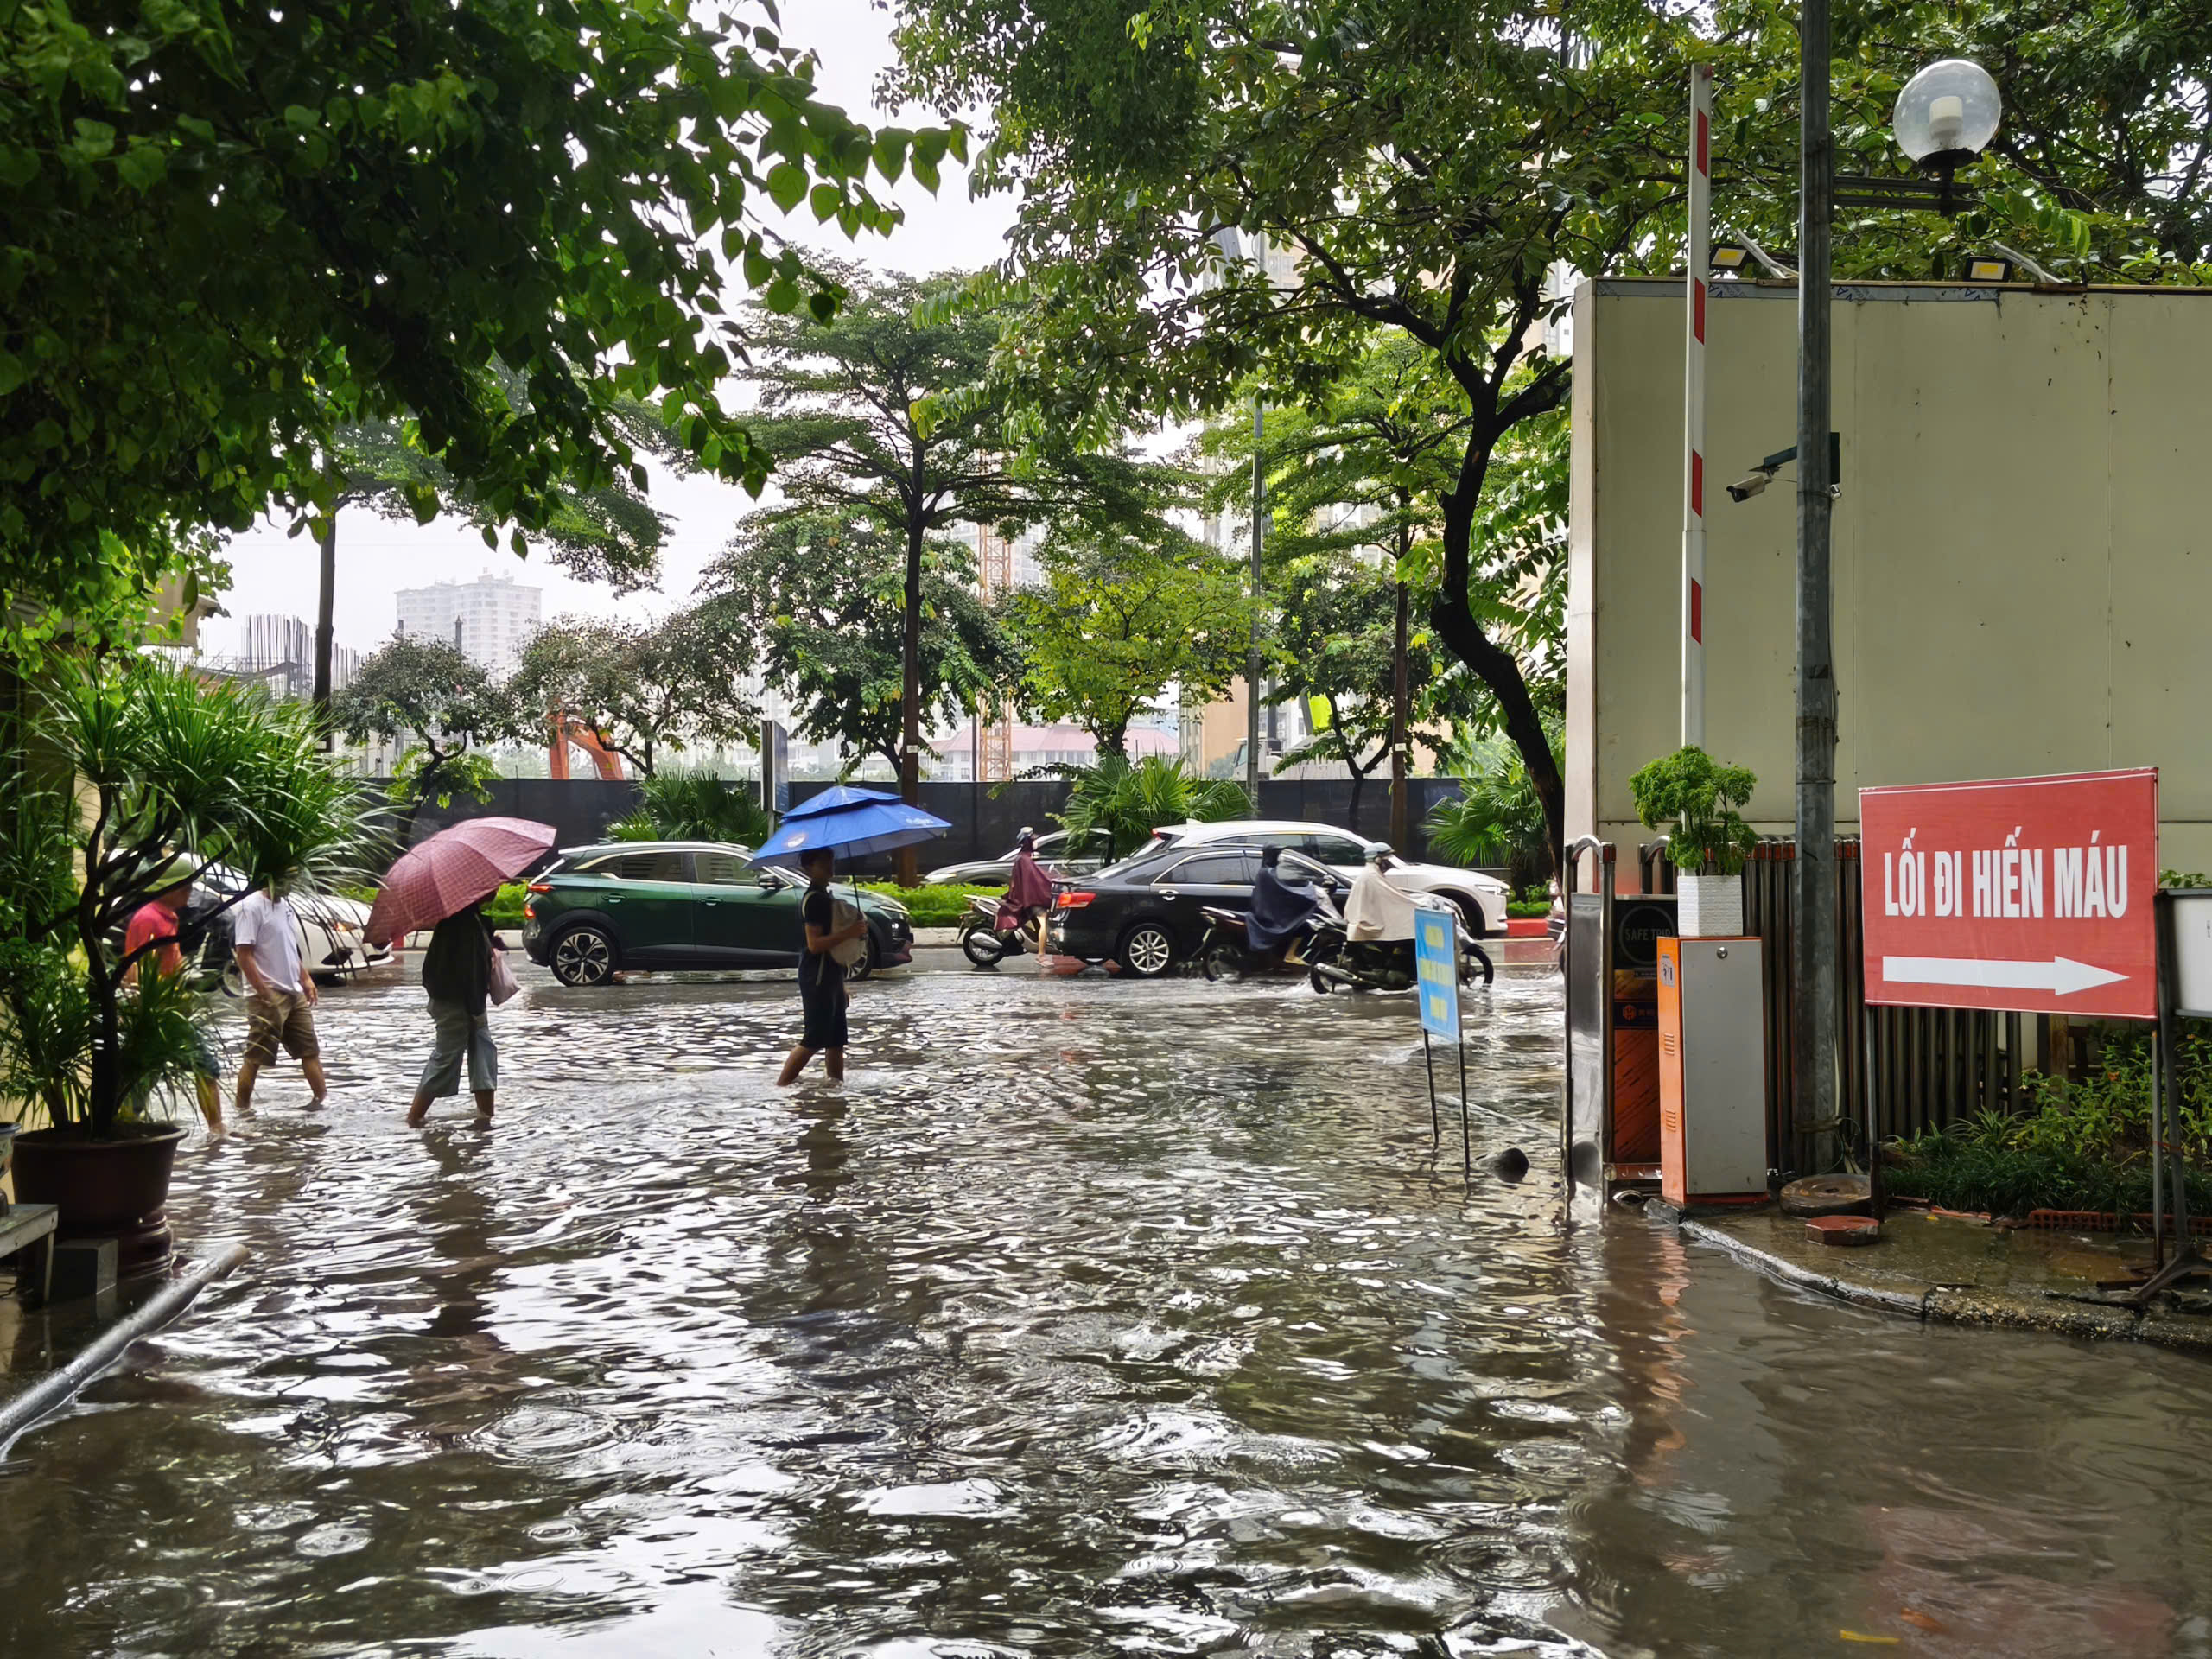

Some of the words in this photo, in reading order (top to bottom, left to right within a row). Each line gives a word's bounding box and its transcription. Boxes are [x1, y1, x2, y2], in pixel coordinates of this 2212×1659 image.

[1884, 827, 1926, 918] LỐI
[1934, 850, 1963, 918] ĐI
[1972, 826, 2044, 918] HIẾN
[2053, 830, 2128, 918] MÁU
[1624, 928, 1649, 941] SAFE
